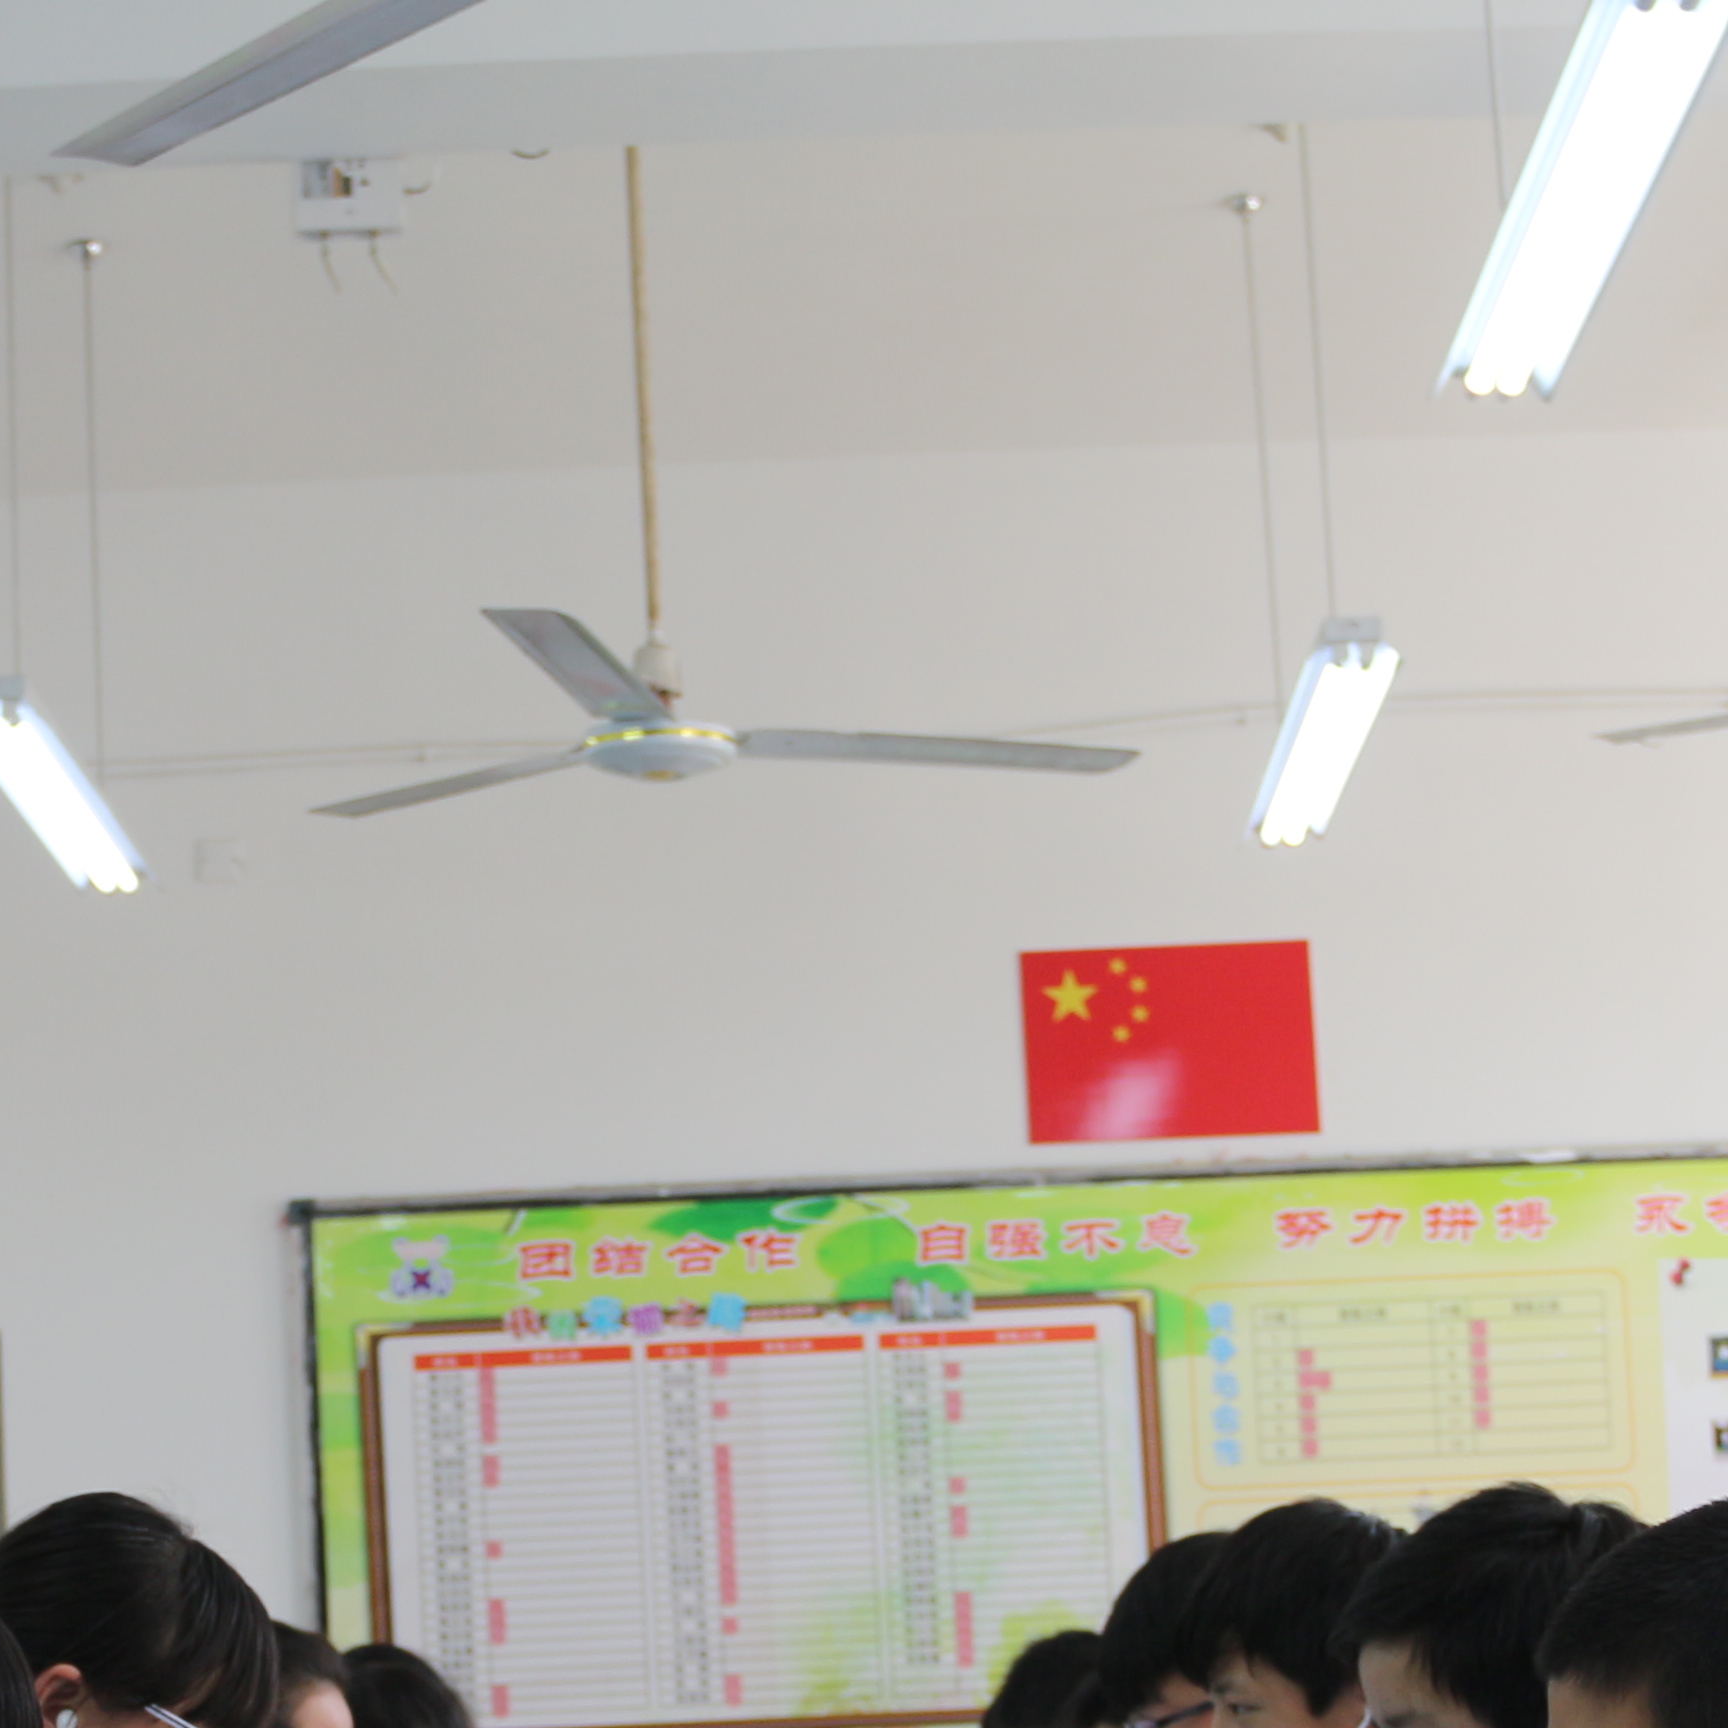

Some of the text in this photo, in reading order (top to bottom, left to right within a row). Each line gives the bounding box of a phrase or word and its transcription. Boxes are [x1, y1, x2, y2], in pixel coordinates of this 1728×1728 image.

[519, 1230, 798, 1280] 团结合作
[920, 1211, 1195, 1262] 自强不息
[1276, 1201, 1553, 1248] 努力拼搏
